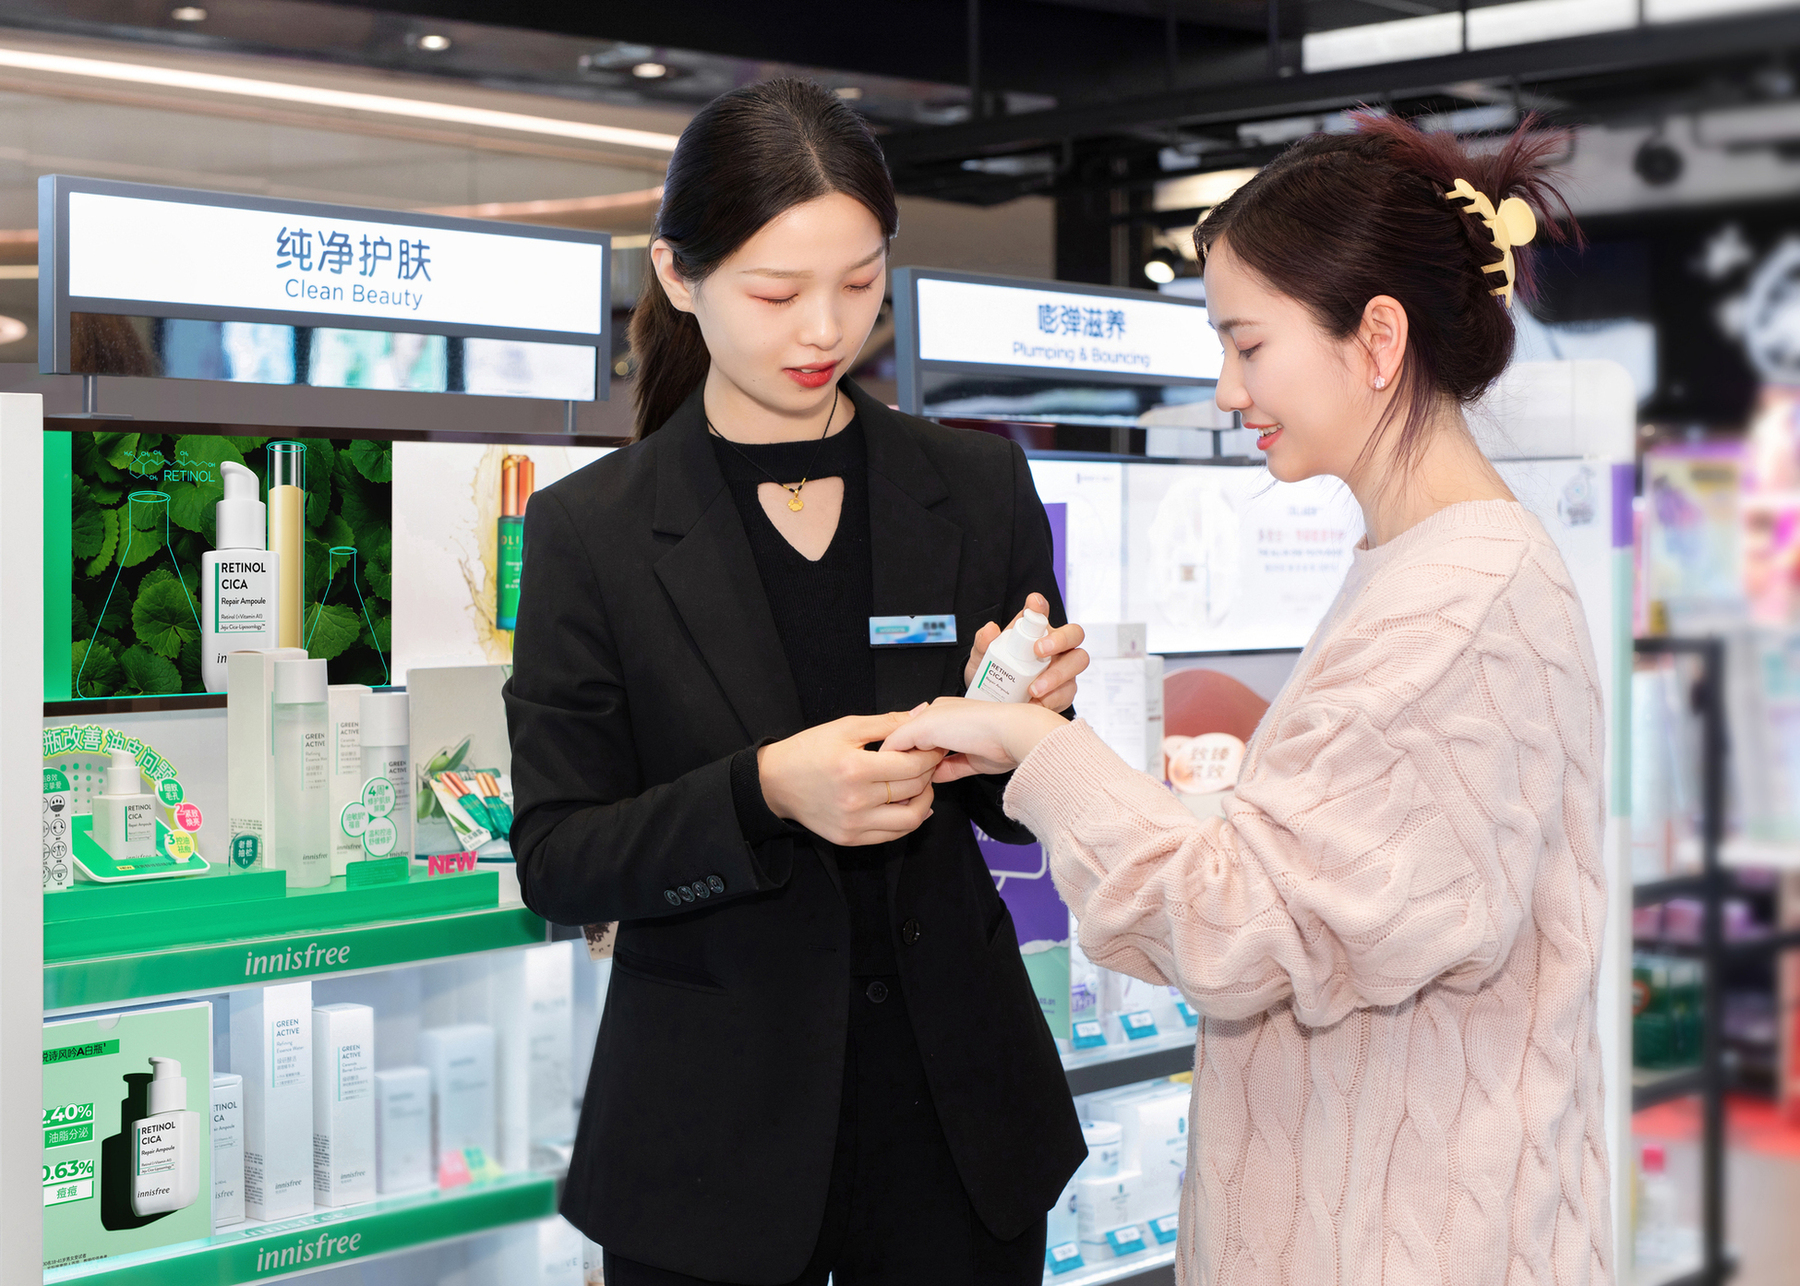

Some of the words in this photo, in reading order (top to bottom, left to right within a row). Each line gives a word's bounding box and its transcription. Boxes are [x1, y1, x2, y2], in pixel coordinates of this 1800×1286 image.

[276, 226, 431, 282] 纯净护肤
[285, 278, 343, 301] Clean
[352, 284, 423, 311] Beauty
[1013, 341, 1075, 363] Plumping
[1079, 347, 1087, 361] &
[1091, 347, 1151, 368] Bouncing
[163, 469, 216, 483] RETINOL
[221, 562, 267, 574] RETINOL
[221, 578, 249, 590] CICA
[221, 597, 239, 607] Repair
[240, 596, 266, 607] Ampoule
[988, 669, 1004, 683] CICA
[991, 662, 1016, 684] RETINOL
[128, 803, 152, 812] RETINOL
[336, 843, 362, 851] innisfree
[428, 851, 479, 878] NEW
[245, 941, 350, 978] innisfree
[276, 1018, 299, 1028] GREEN
[276, 1027, 300, 1037] ACTIVE
[341, 1044, 361, 1052] GREEN
[341, 1051, 361, 1060] ACTIVE
[141, 1121, 176, 1135] RETINOL
[48, 1126, 89, 1144] 油脂分泌
[141, 1137, 162, 1146] CICA
[155, 1145, 175, 1154] Ampoule
[341, 1170, 366, 1180] innisfree
[275, 1179, 302, 1190] innisfree
[56, 1185, 78, 1200] 痘痘
[137, 1186, 170, 1199] innisfree
[214, 1189, 235, 1200] isfree
[256, 1232, 362, 1272] innisfree
